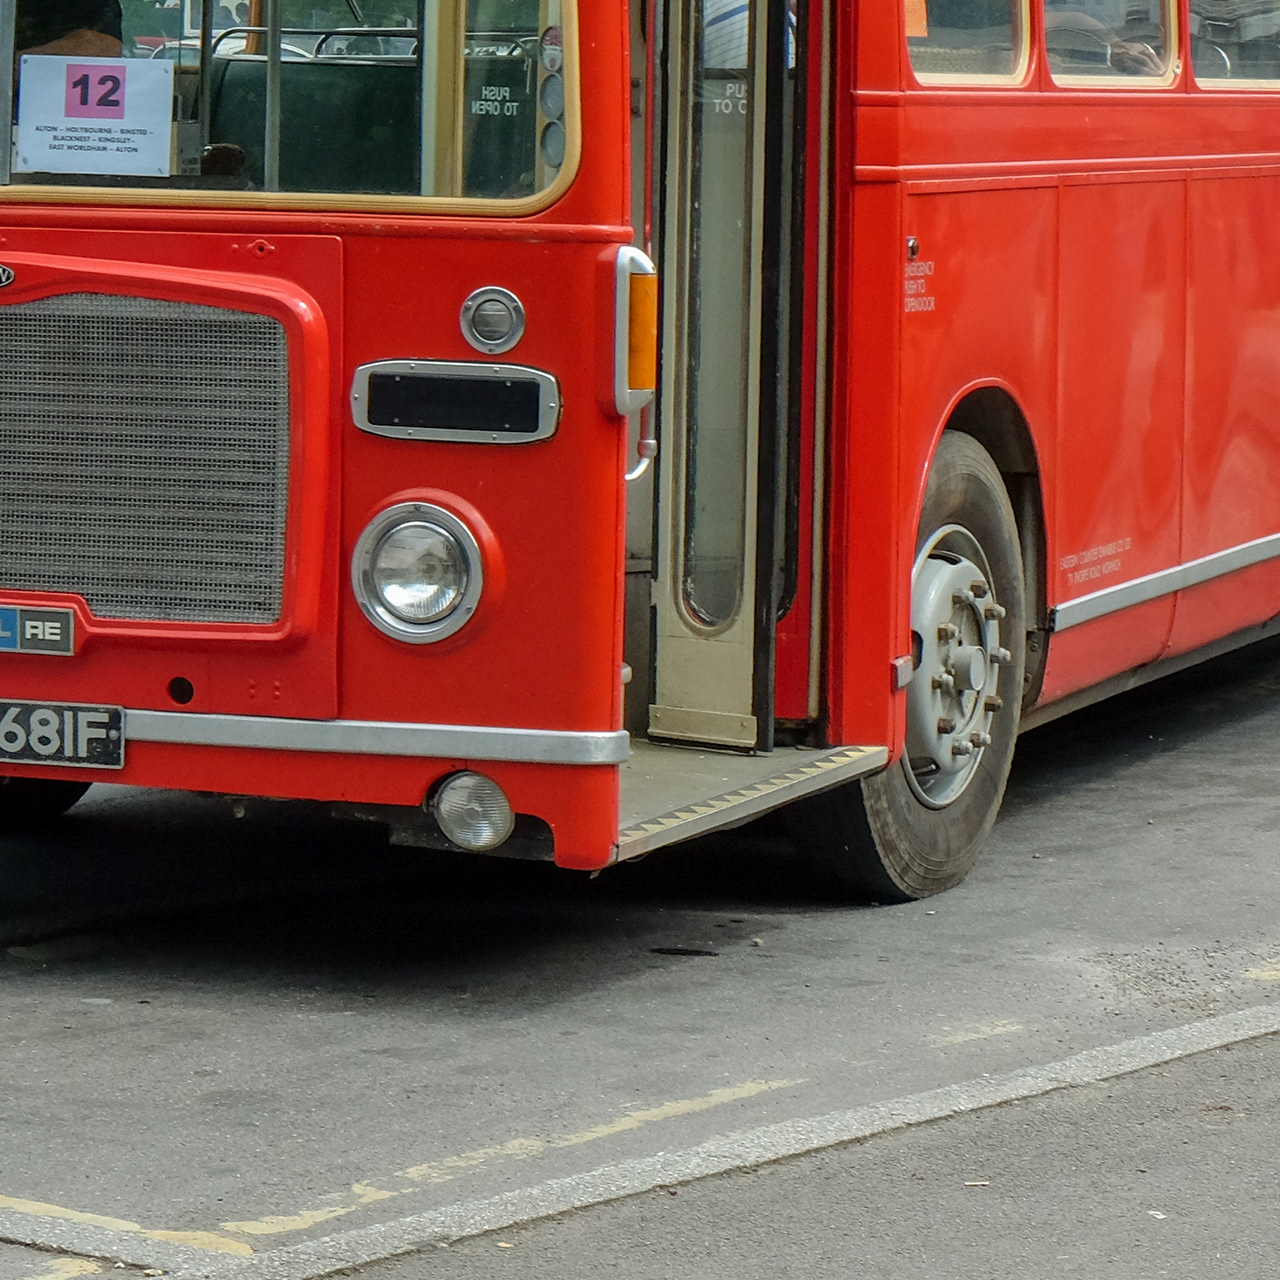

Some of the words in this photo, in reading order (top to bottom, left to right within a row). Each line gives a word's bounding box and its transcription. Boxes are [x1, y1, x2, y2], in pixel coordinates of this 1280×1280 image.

[72, 74, 121, 107] 12
[713, 99, 732, 114] TO
[25, 621, 61, 640] RE
